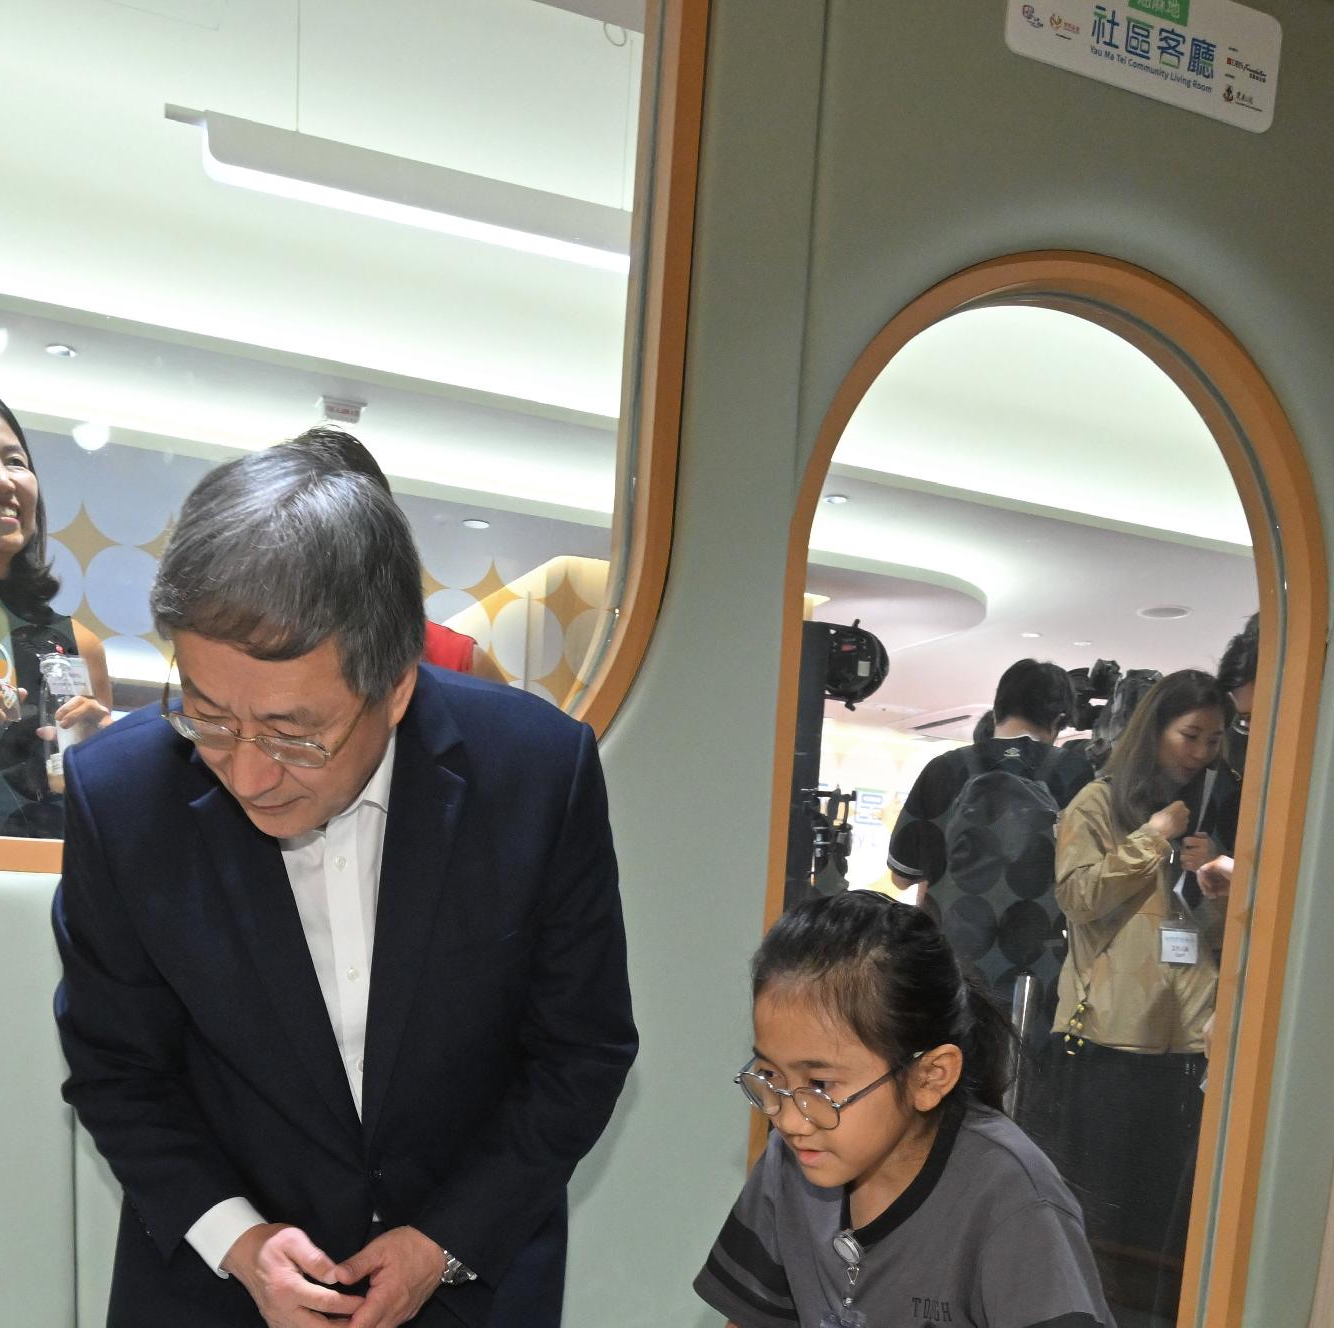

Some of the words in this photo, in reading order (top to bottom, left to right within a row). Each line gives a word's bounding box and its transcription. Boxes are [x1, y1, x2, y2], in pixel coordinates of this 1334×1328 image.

[1090, 4, 1217, 80] 社區客廳
[1090, 45, 1102, 57] Yau
[1104, 50, 1115, 61] Ma
[1116, 54, 1127, 65] Tei
[1128, 58, 1170, 80] Community
[1170, 72, 1192, 89] Living
[1192, 79, 1212, 94] Room
